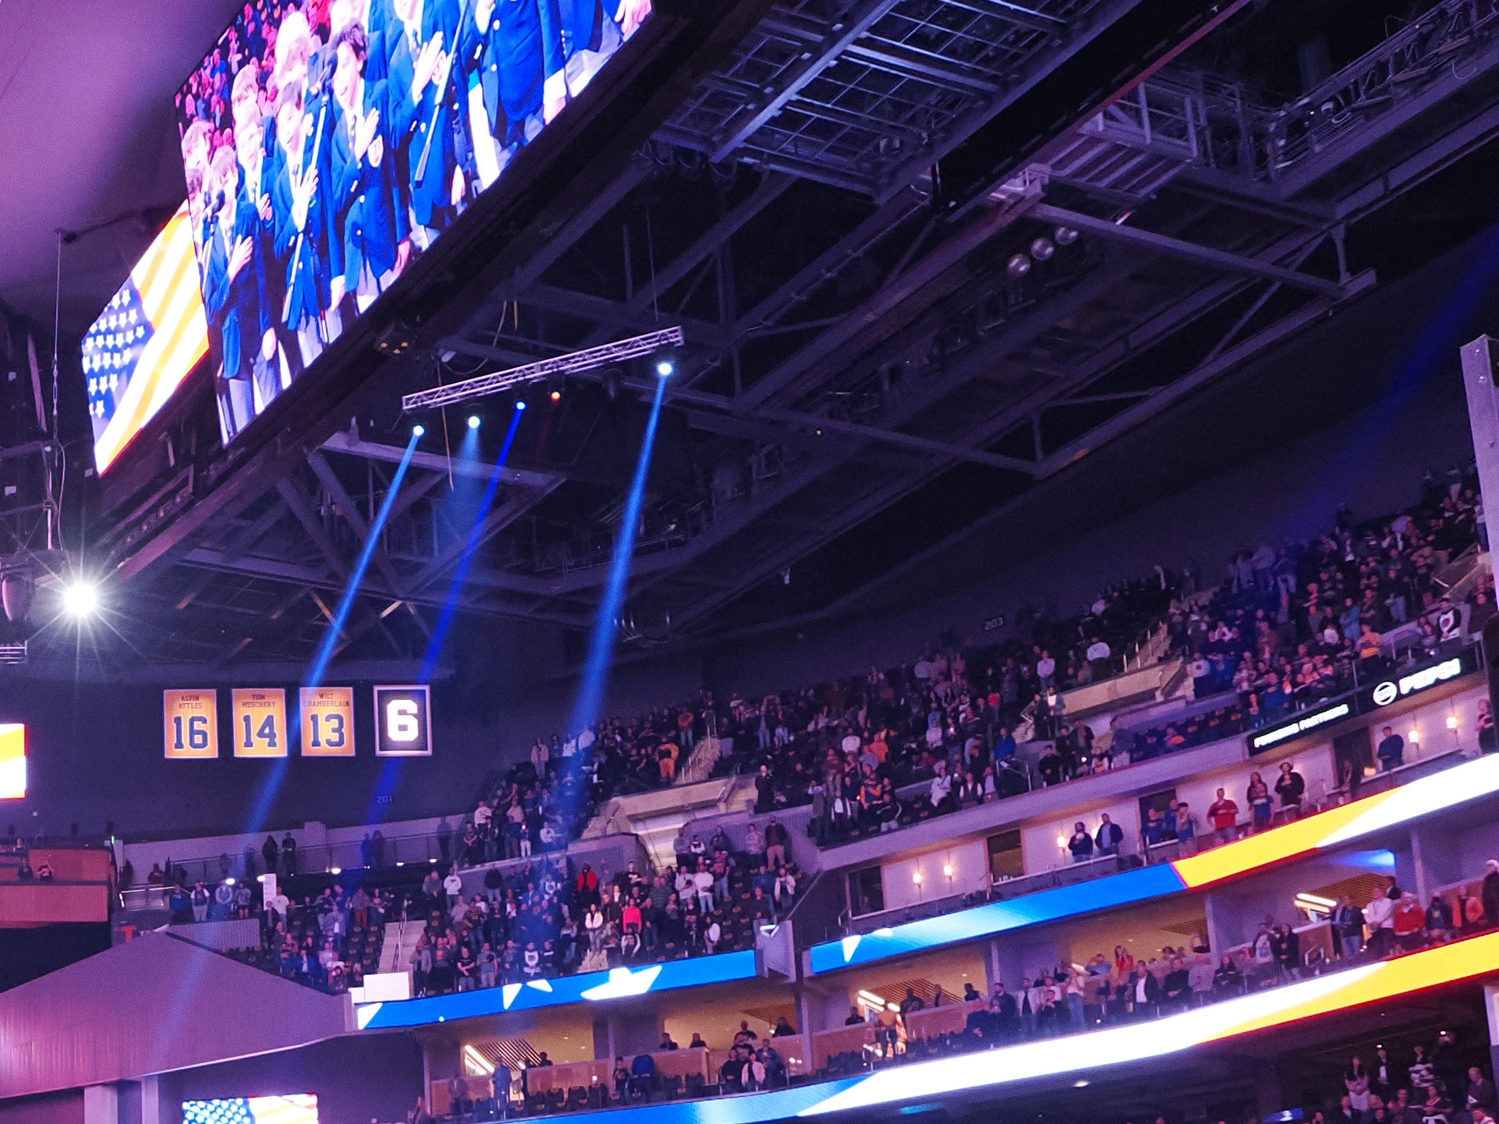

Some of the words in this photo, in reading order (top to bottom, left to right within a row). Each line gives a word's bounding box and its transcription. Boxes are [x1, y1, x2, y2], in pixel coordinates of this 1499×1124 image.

[984, 617, 1004, 630] 203
[173, 715, 209, 750] 16
[243, 714, 278, 748] 14
[311, 713, 345, 748] 13
[386, 699, 419, 742] 6
